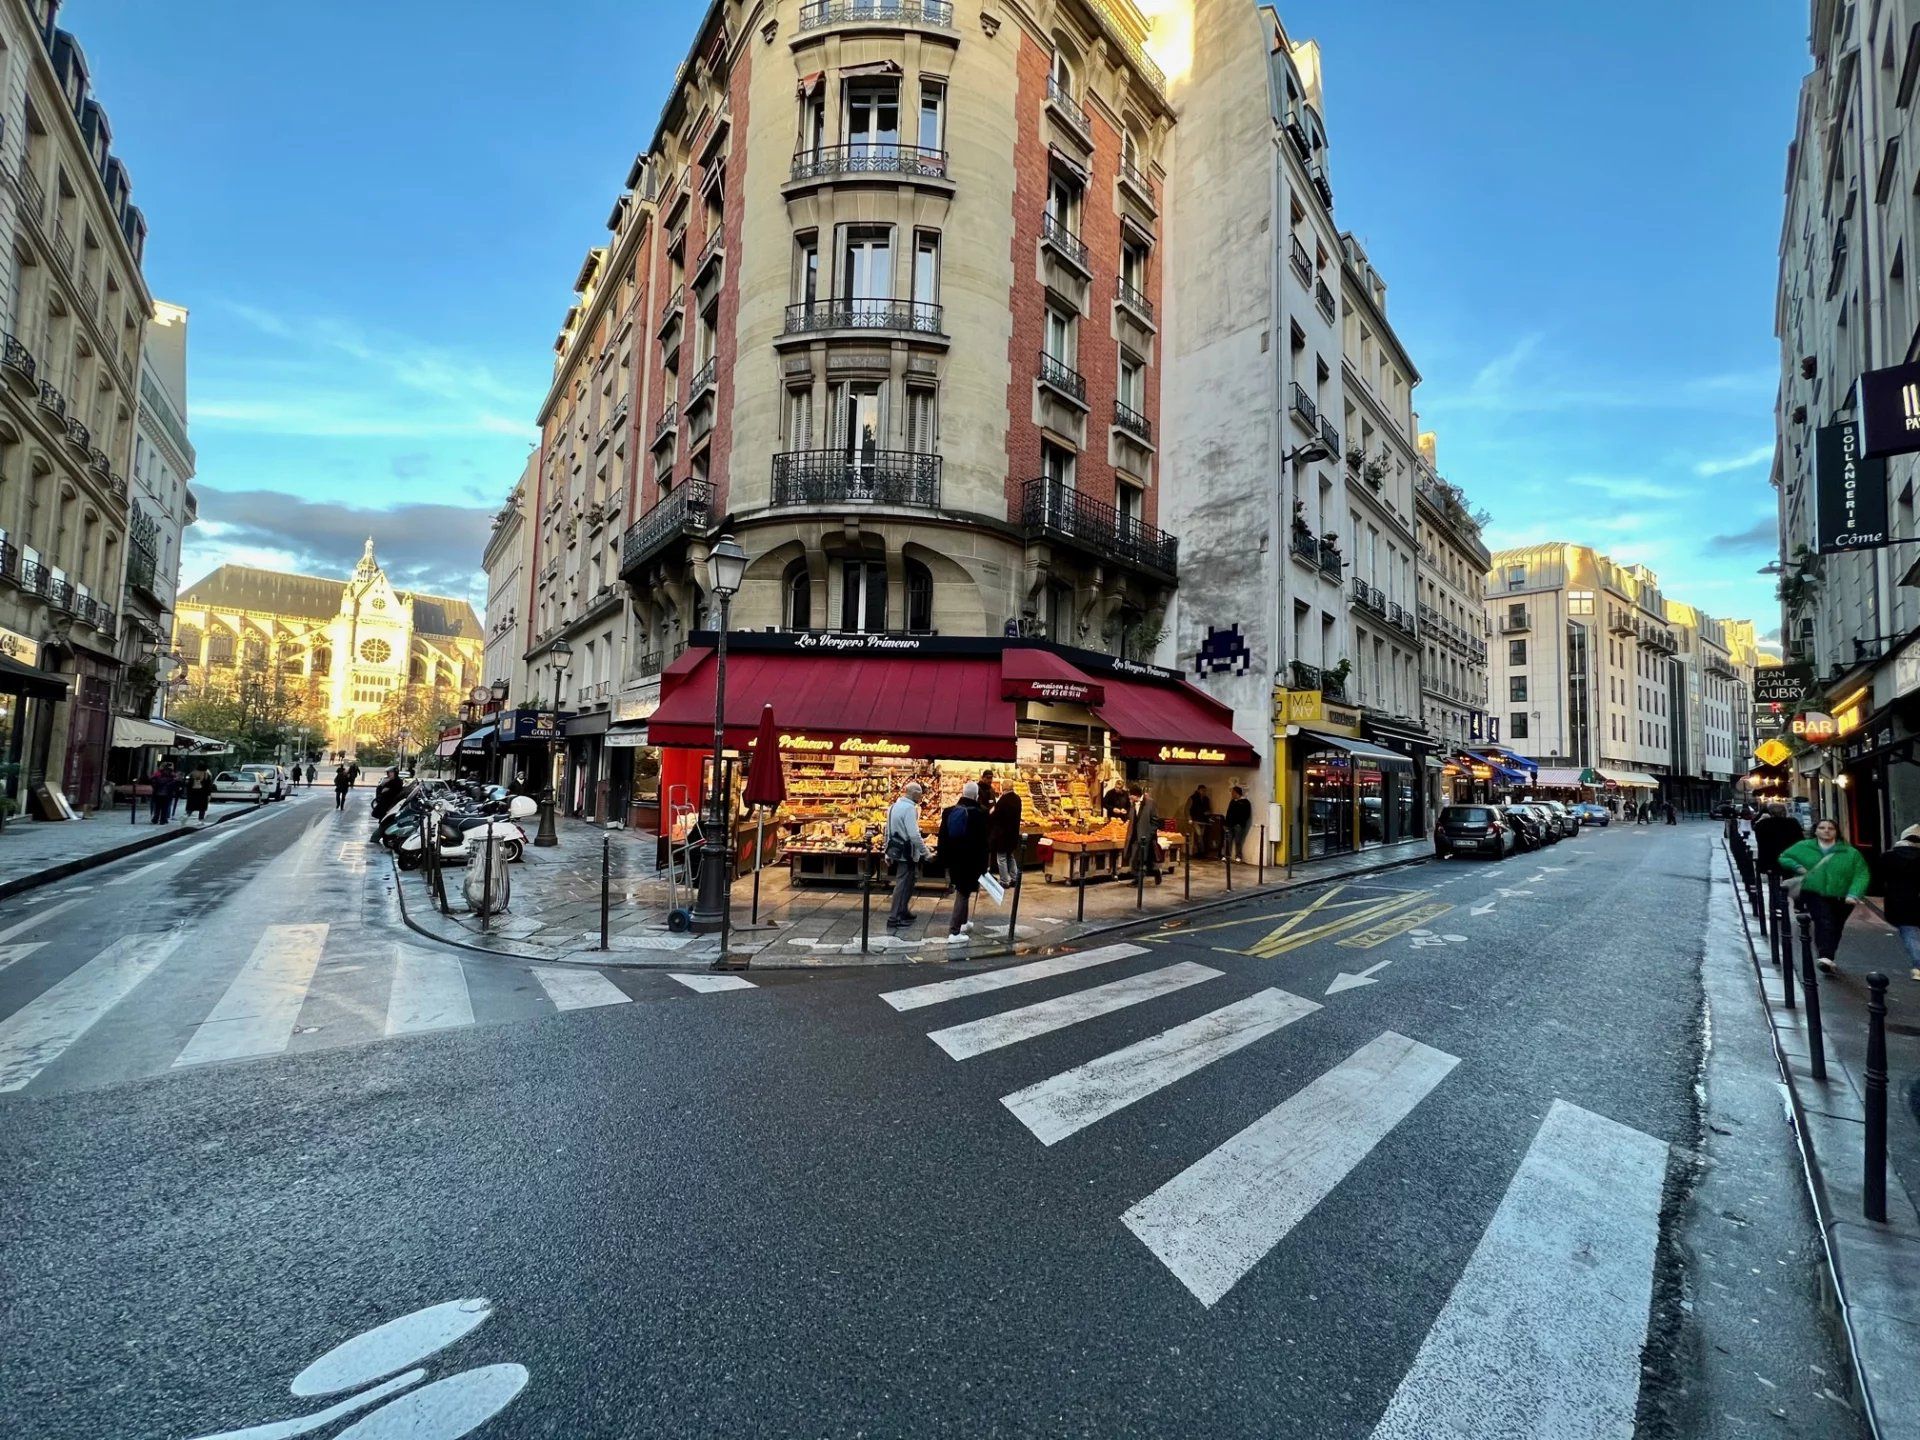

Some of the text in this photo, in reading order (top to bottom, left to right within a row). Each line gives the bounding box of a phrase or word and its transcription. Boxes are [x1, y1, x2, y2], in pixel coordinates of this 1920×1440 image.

[1906, 416, 1920, 431] PA
[1843, 426, 1856, 528] BOULANGERIE
[1835, 532, 1882, 547] Côme
[794, 634, 920, 649] Les Vergers Primeurs
[1758, 670, 1785, 679] JEAN
[1757, 678, 1800, 687] CLAUDE
[1758, 687, 1806, 699] AUBRY
[1792, 721, 1833, 734] BAR
[778, 734, 911, 754] Primeurs d'Excellence
